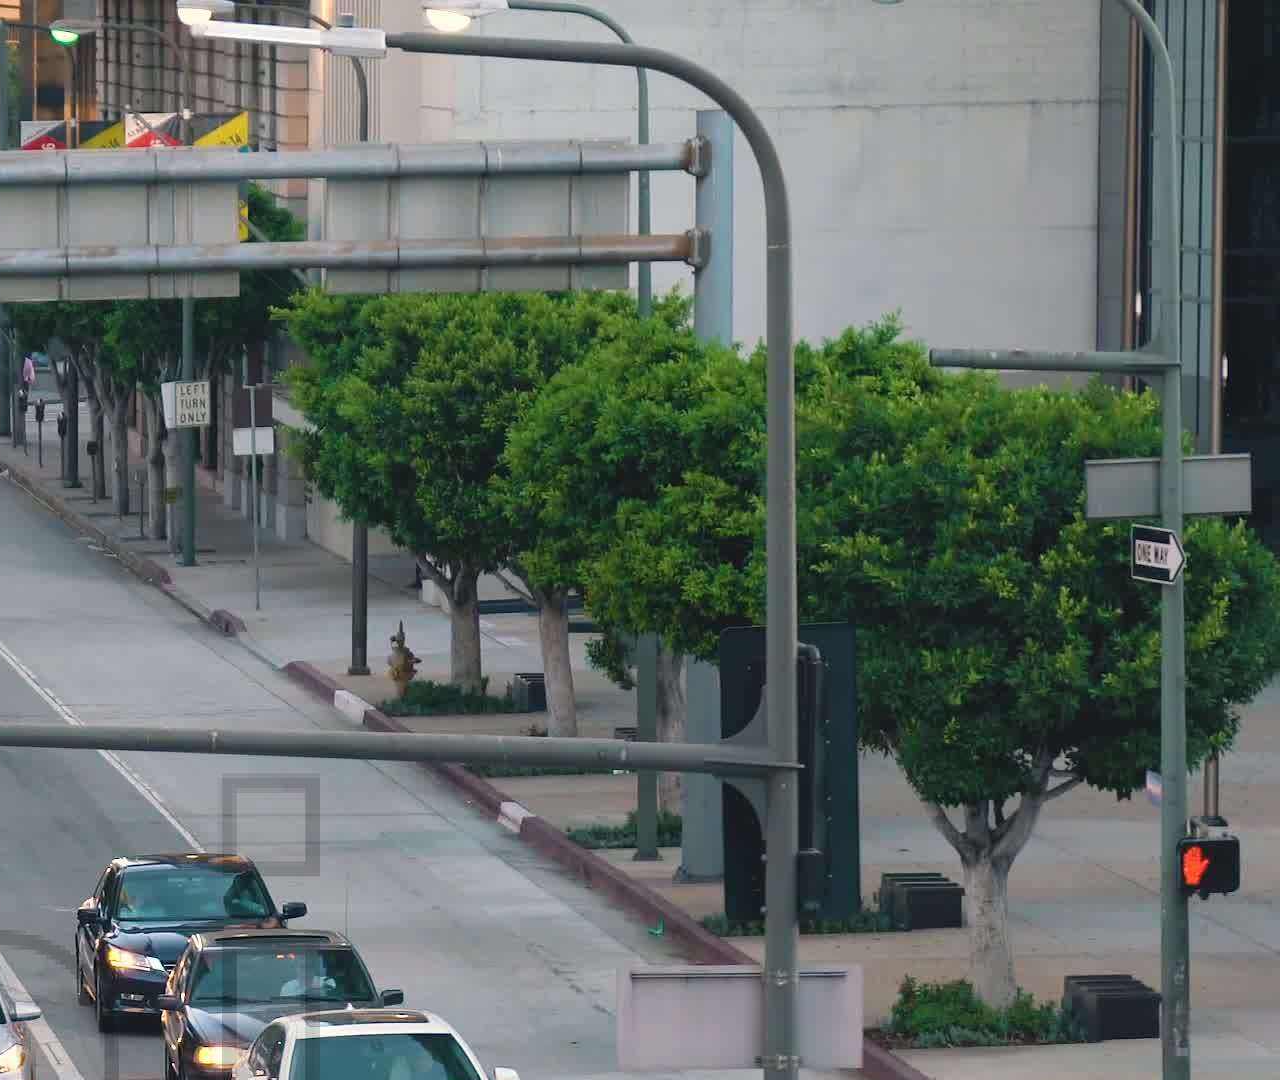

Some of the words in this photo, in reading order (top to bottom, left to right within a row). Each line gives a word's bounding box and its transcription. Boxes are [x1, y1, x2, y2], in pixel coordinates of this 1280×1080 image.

[180, 384, 206, 396] LEFT
[180, 398, 206, 409] TURN
[180, 411, 207, 424] ONLY
[1136, 543, 1152, 563] ONE
[1153, 544, 1169, 564] WAY
